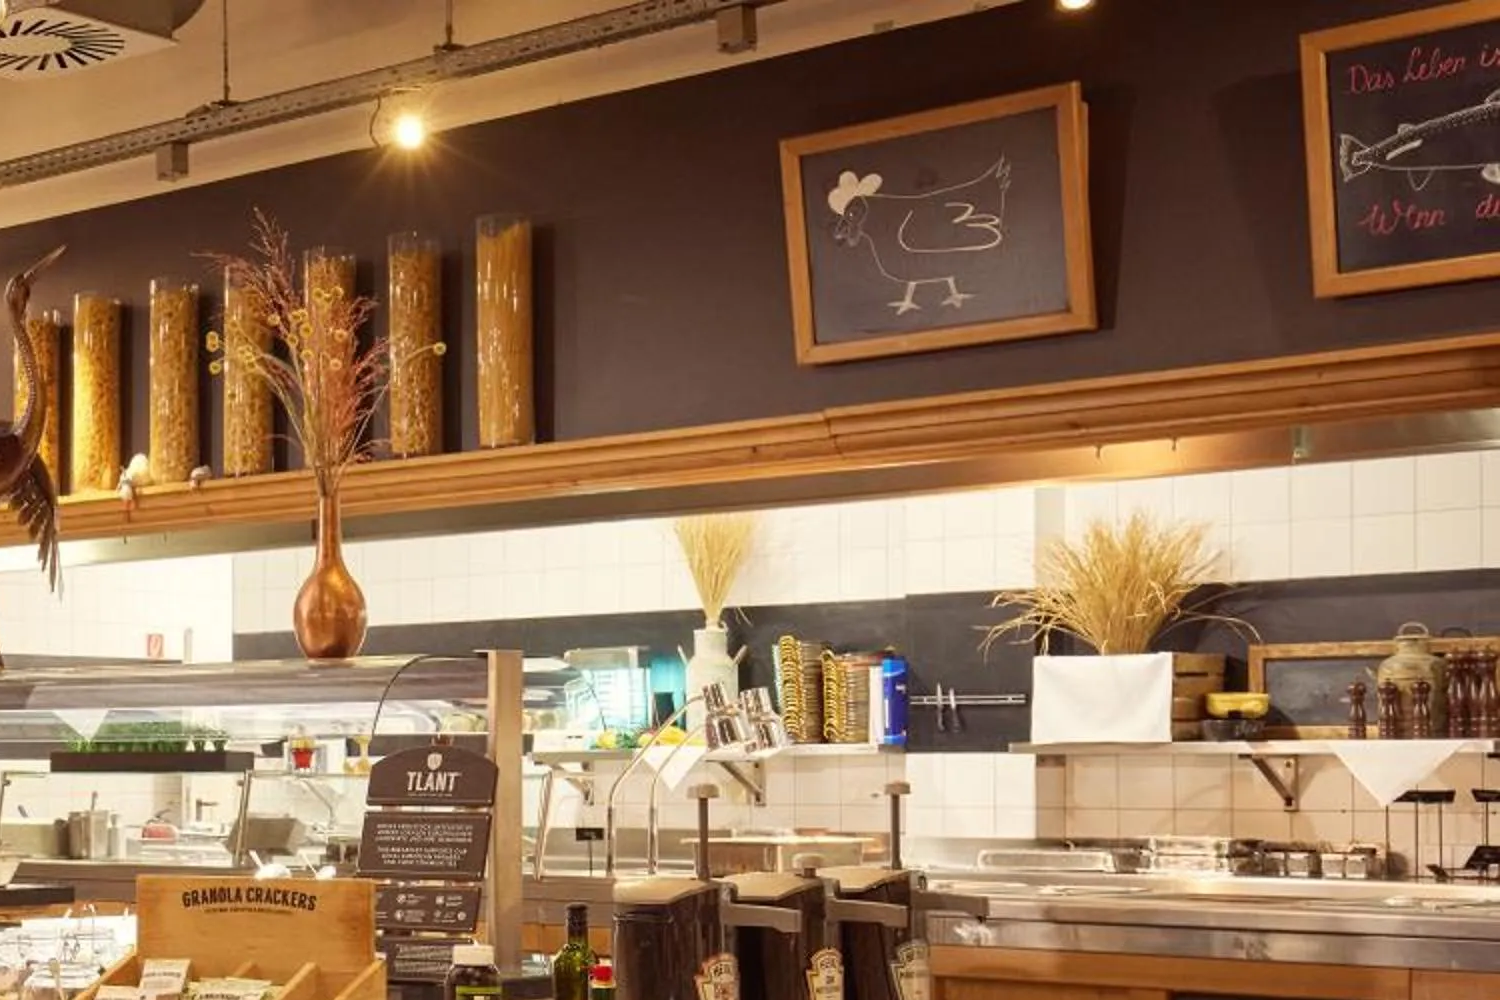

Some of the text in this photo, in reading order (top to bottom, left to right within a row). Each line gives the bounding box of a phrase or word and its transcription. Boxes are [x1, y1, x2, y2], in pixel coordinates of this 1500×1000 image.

[1347, 64, 1395, 94] Das
[1402, 47, 1466, 82] Leben
[406, 771, 461, 792] TLANT
[182, 887, 317, 911] GRANOLA CRACKERS
